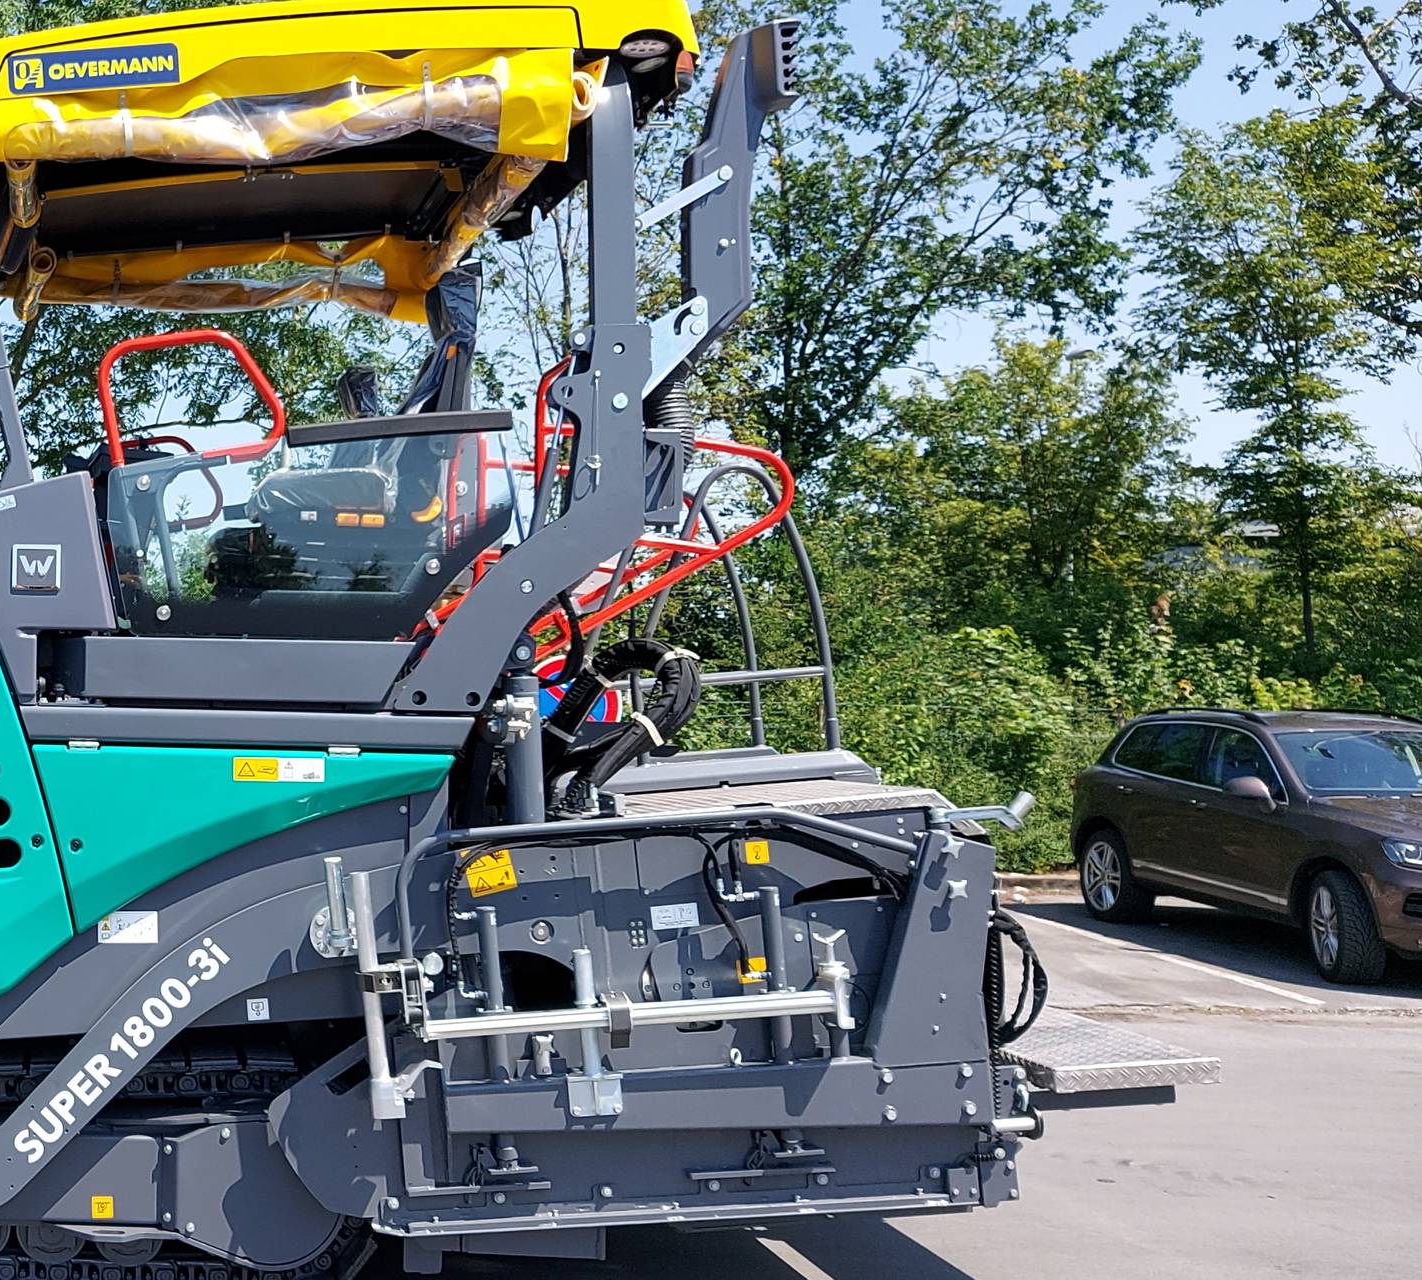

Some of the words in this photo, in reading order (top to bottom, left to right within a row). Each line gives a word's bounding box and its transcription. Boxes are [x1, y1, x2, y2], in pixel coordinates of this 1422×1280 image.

[48, 55, 174, 80] OEVERMANN
[14, 1053, 123, 1164] SUPER
[110, 937, 230, 1060] 1800-3i
